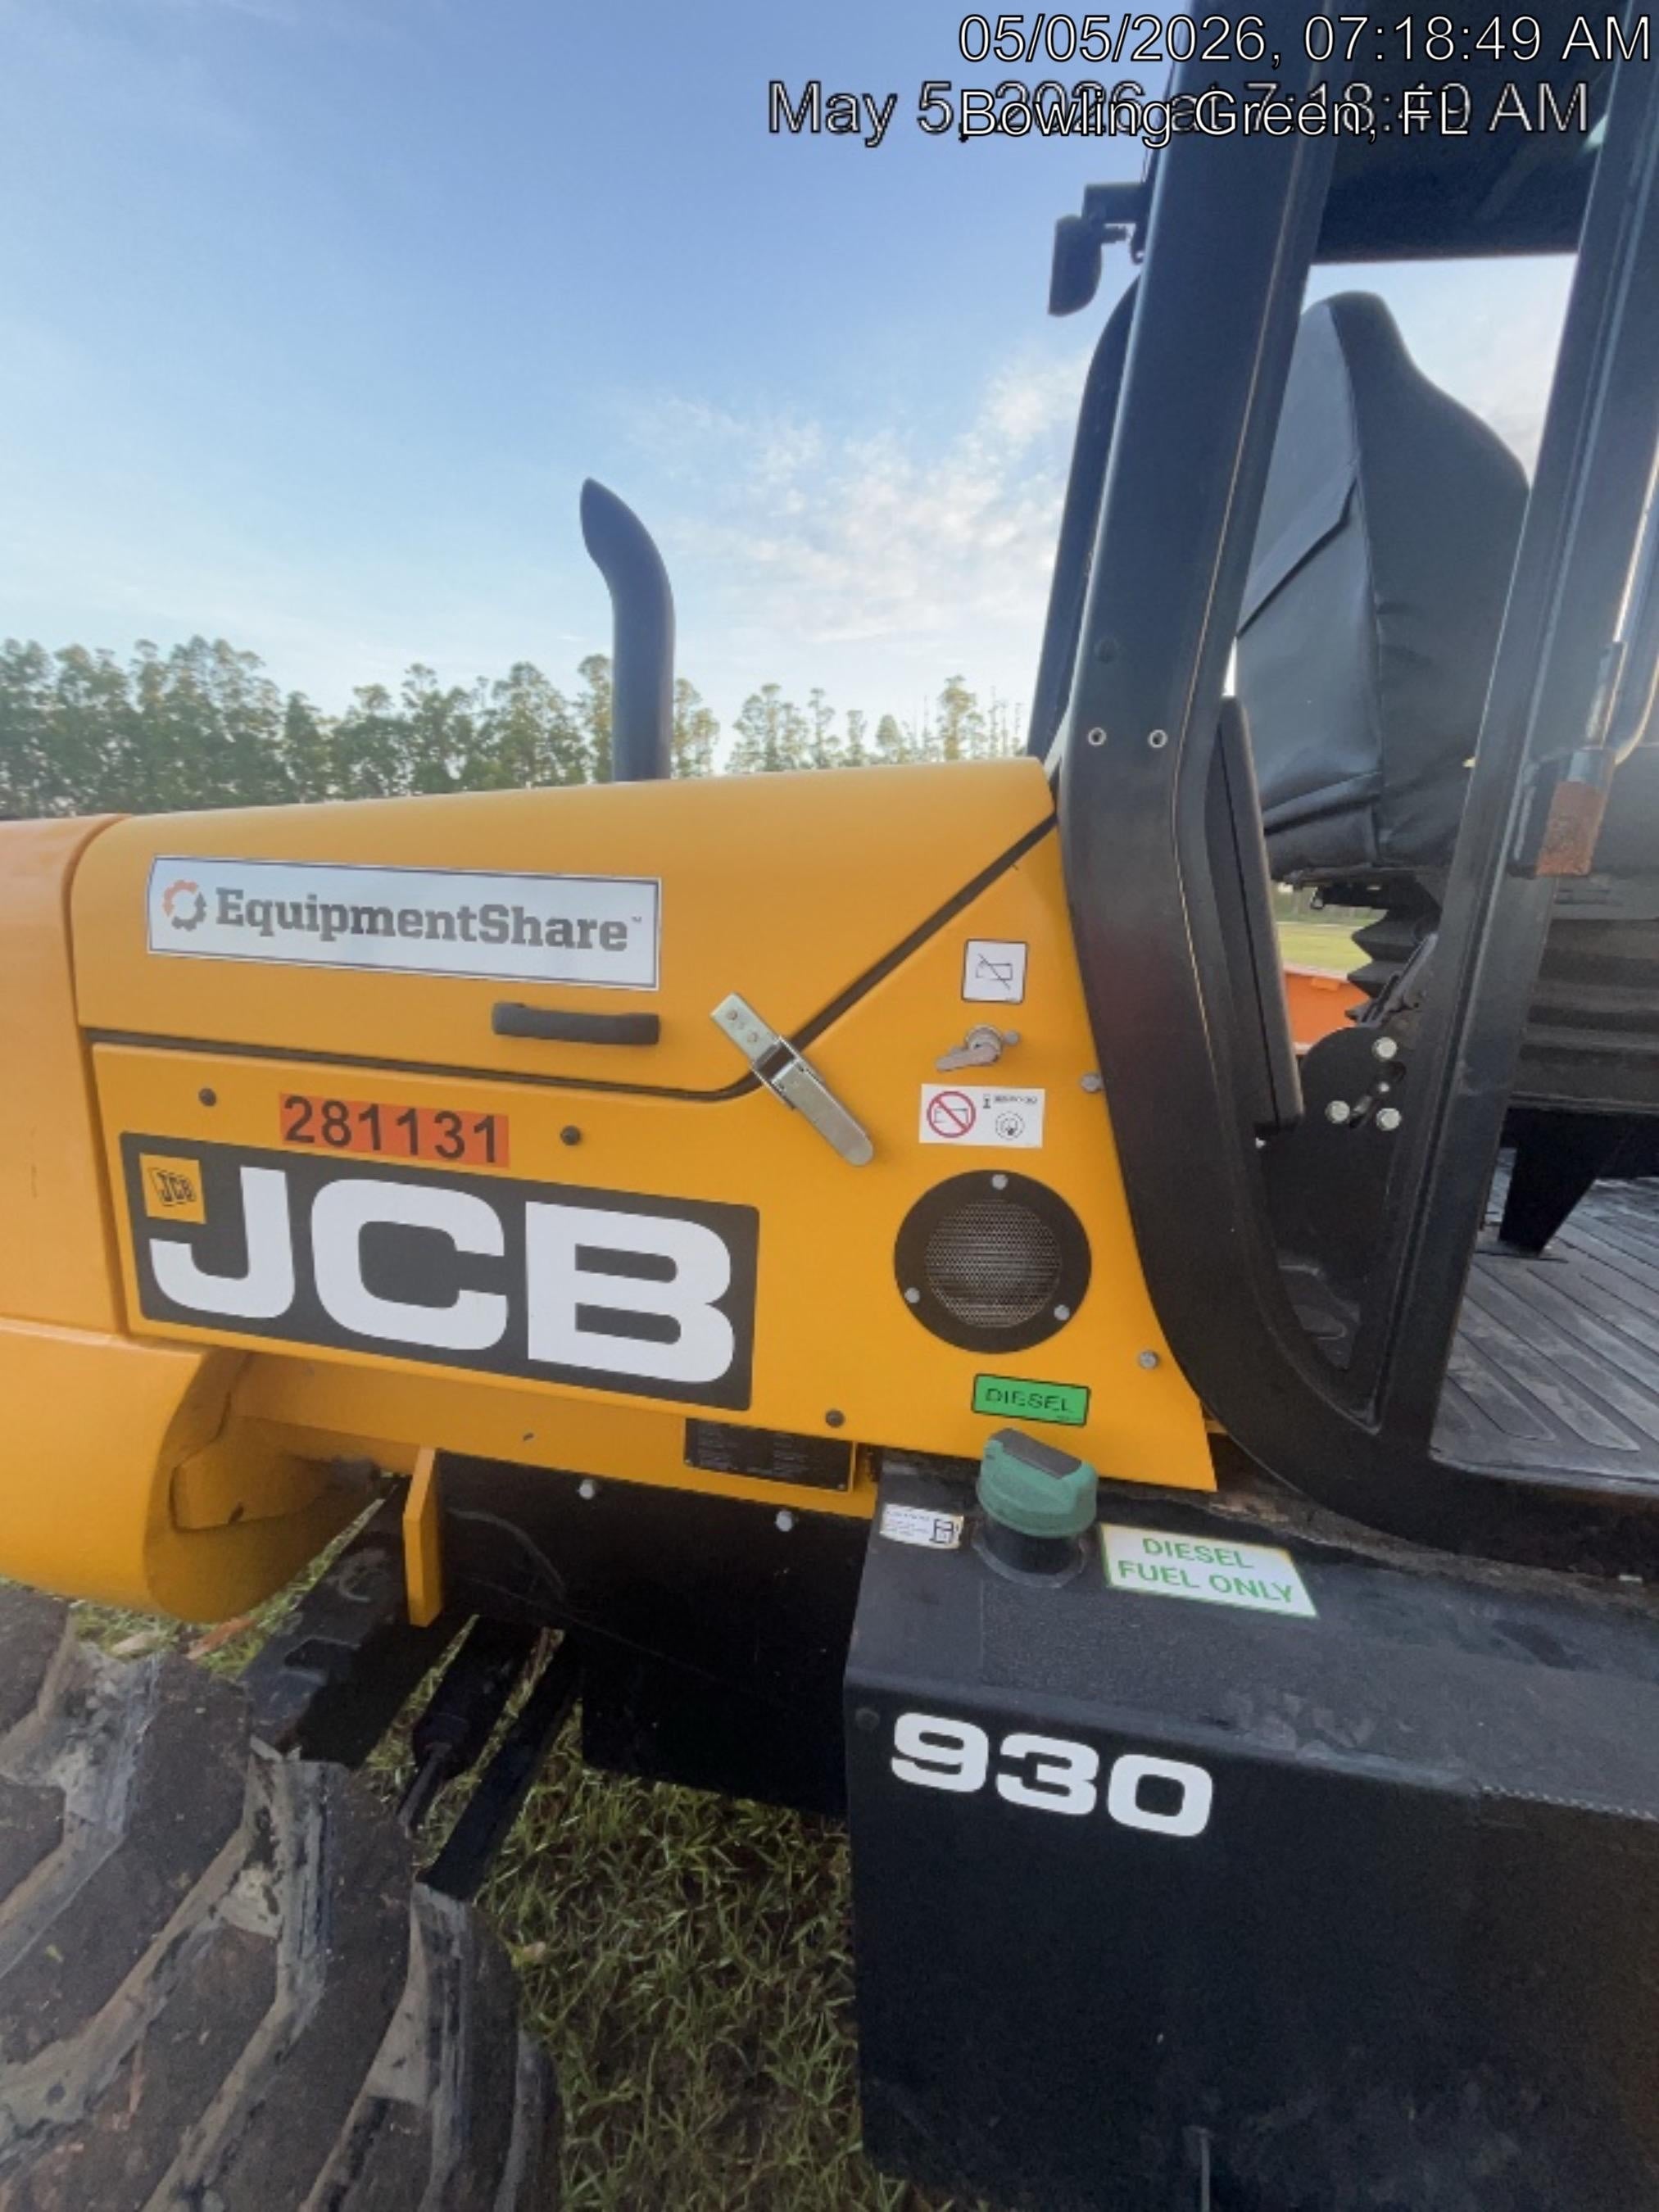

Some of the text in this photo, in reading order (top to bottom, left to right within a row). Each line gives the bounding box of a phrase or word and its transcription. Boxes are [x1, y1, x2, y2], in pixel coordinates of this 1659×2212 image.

[215, 887, 628, 952] EquipmentShare
[283, 1095, 499, 1164] 281131
[149, 1166, 736, 1383] JCB
[985, 1388, 1075, 1414] DIESEL
[1117, 1560, 1293, 1603] FUEL ONLY
[1142, 1538, 1255, 1569] DIESEL
[891, 1711, 1213, 1838] 930
